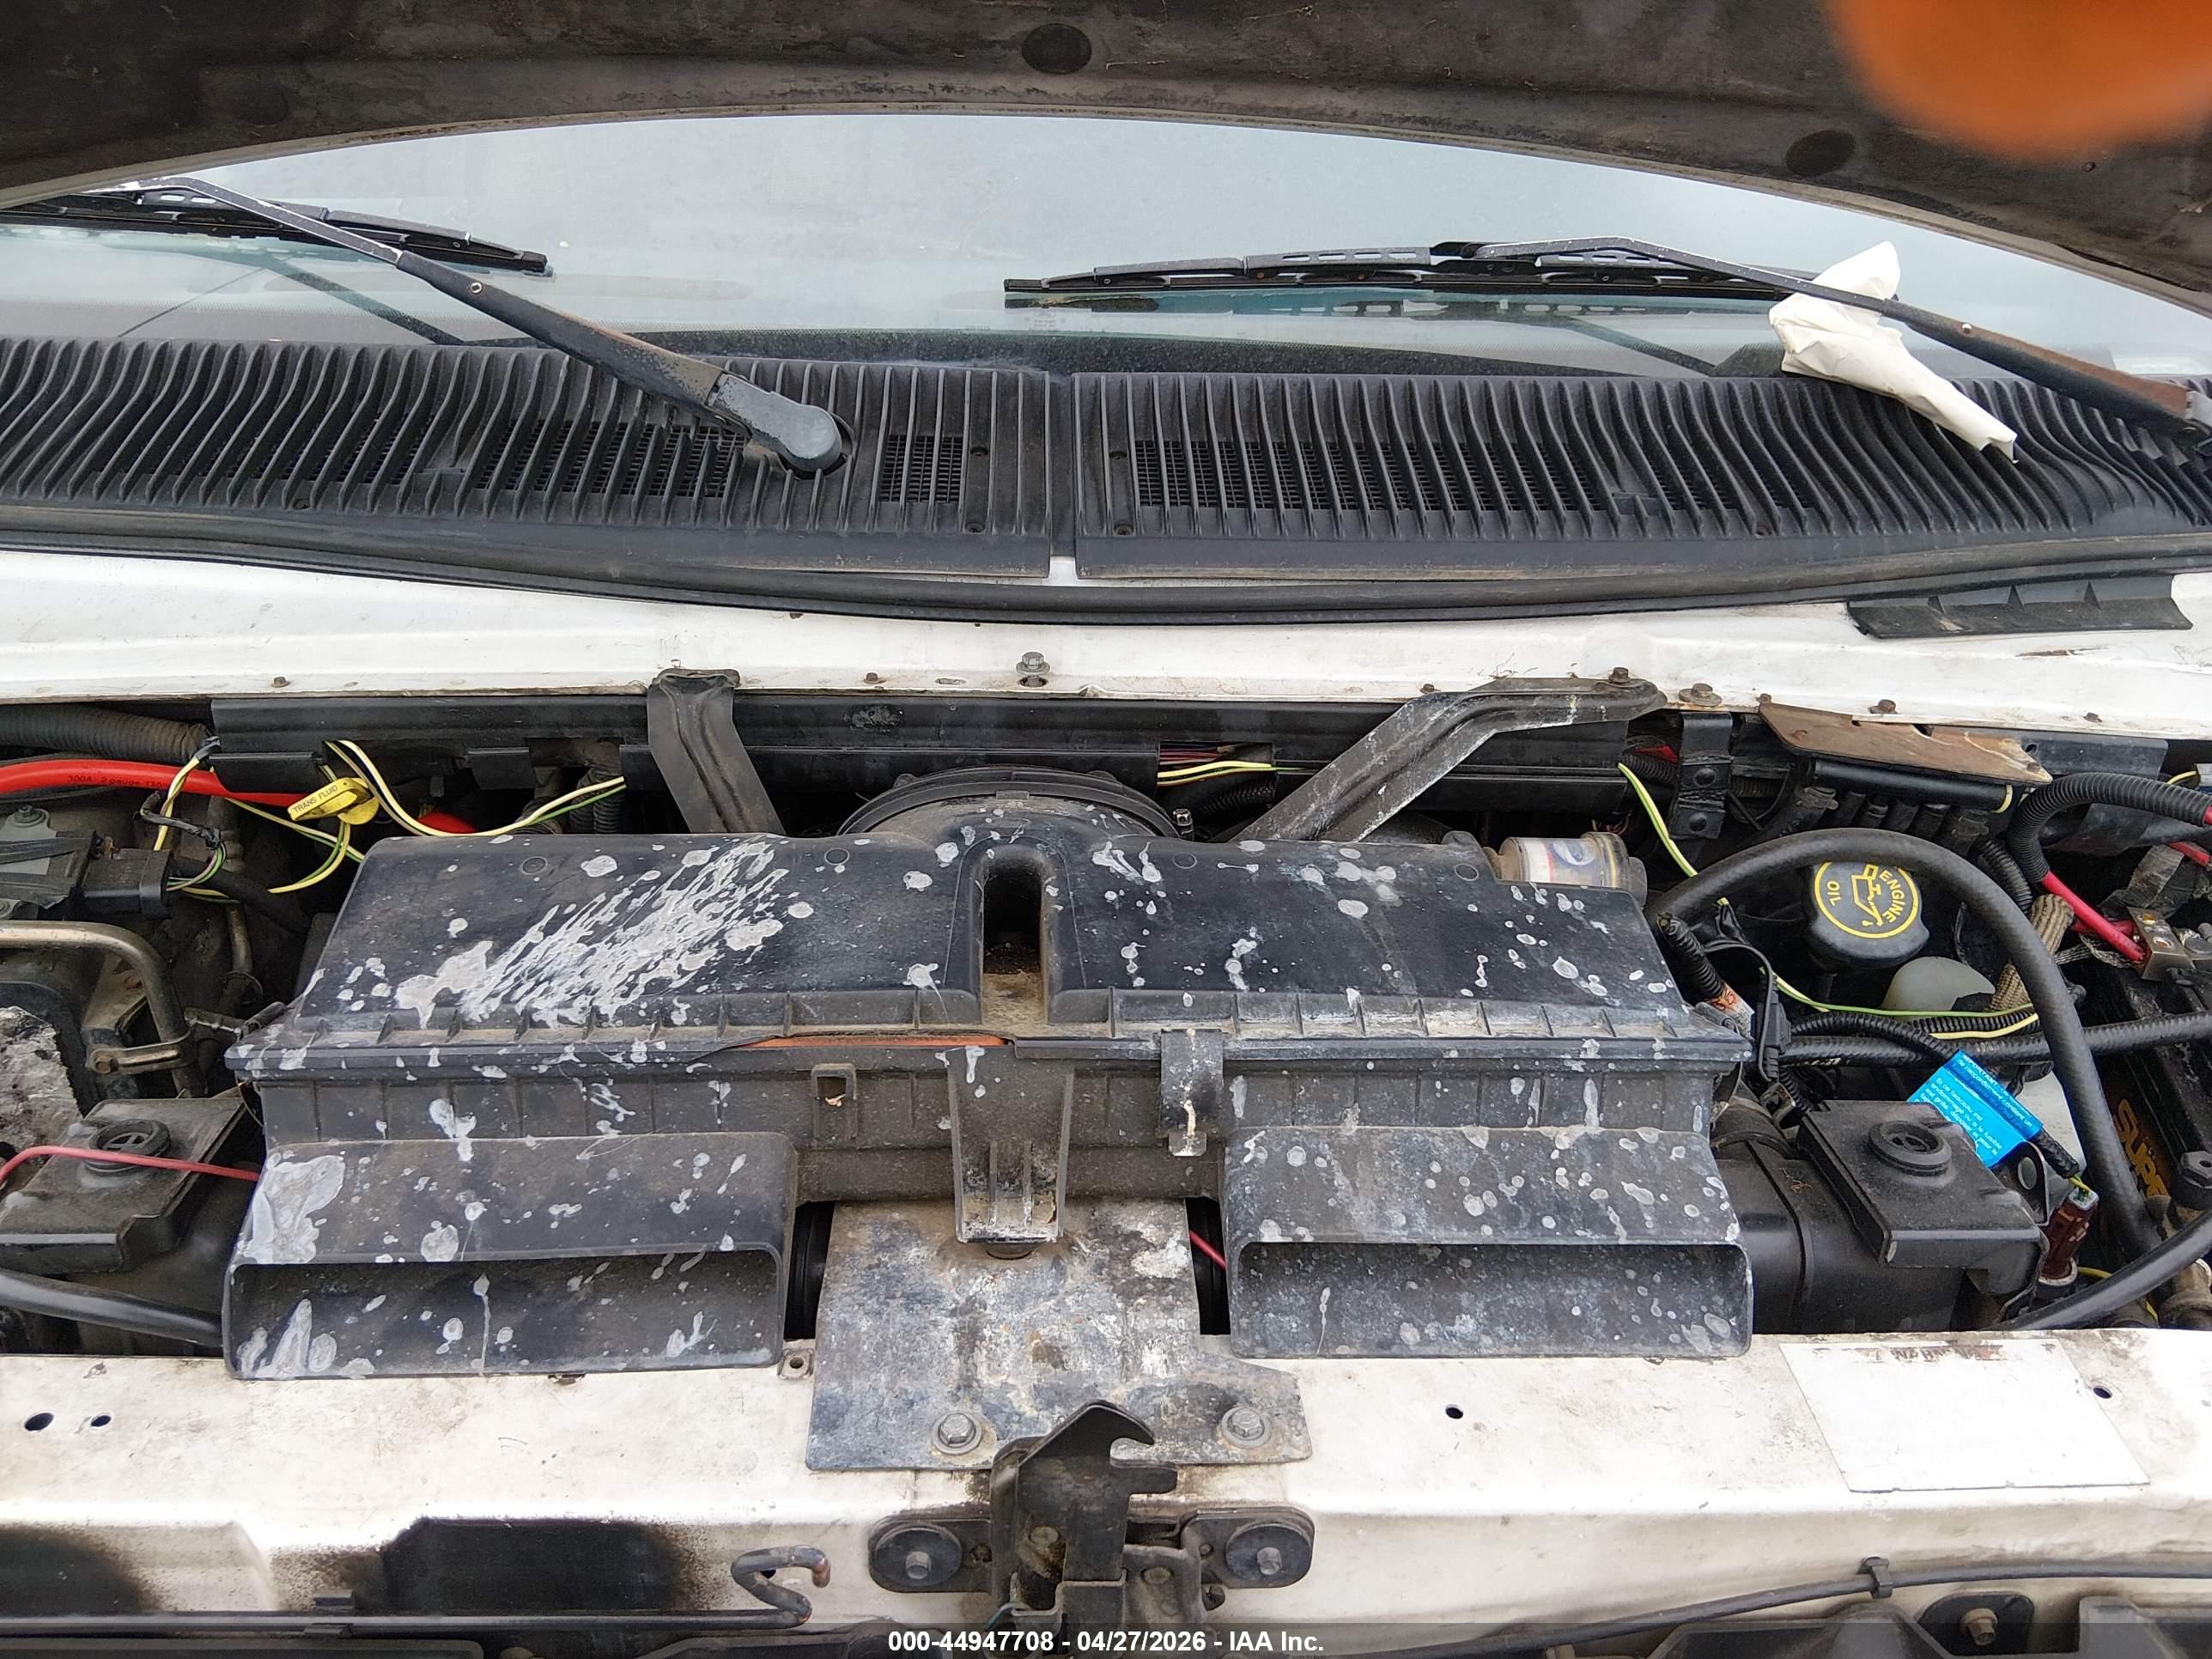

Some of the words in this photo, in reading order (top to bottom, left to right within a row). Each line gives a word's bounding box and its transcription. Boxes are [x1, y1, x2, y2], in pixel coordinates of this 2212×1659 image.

[293, 796, 318, 814] TRANS
[319, 785, 338, 800] FLUID
[1826, 879, 1842, 907] OIL
[1879, 869, 1905, 923] ENGINE
